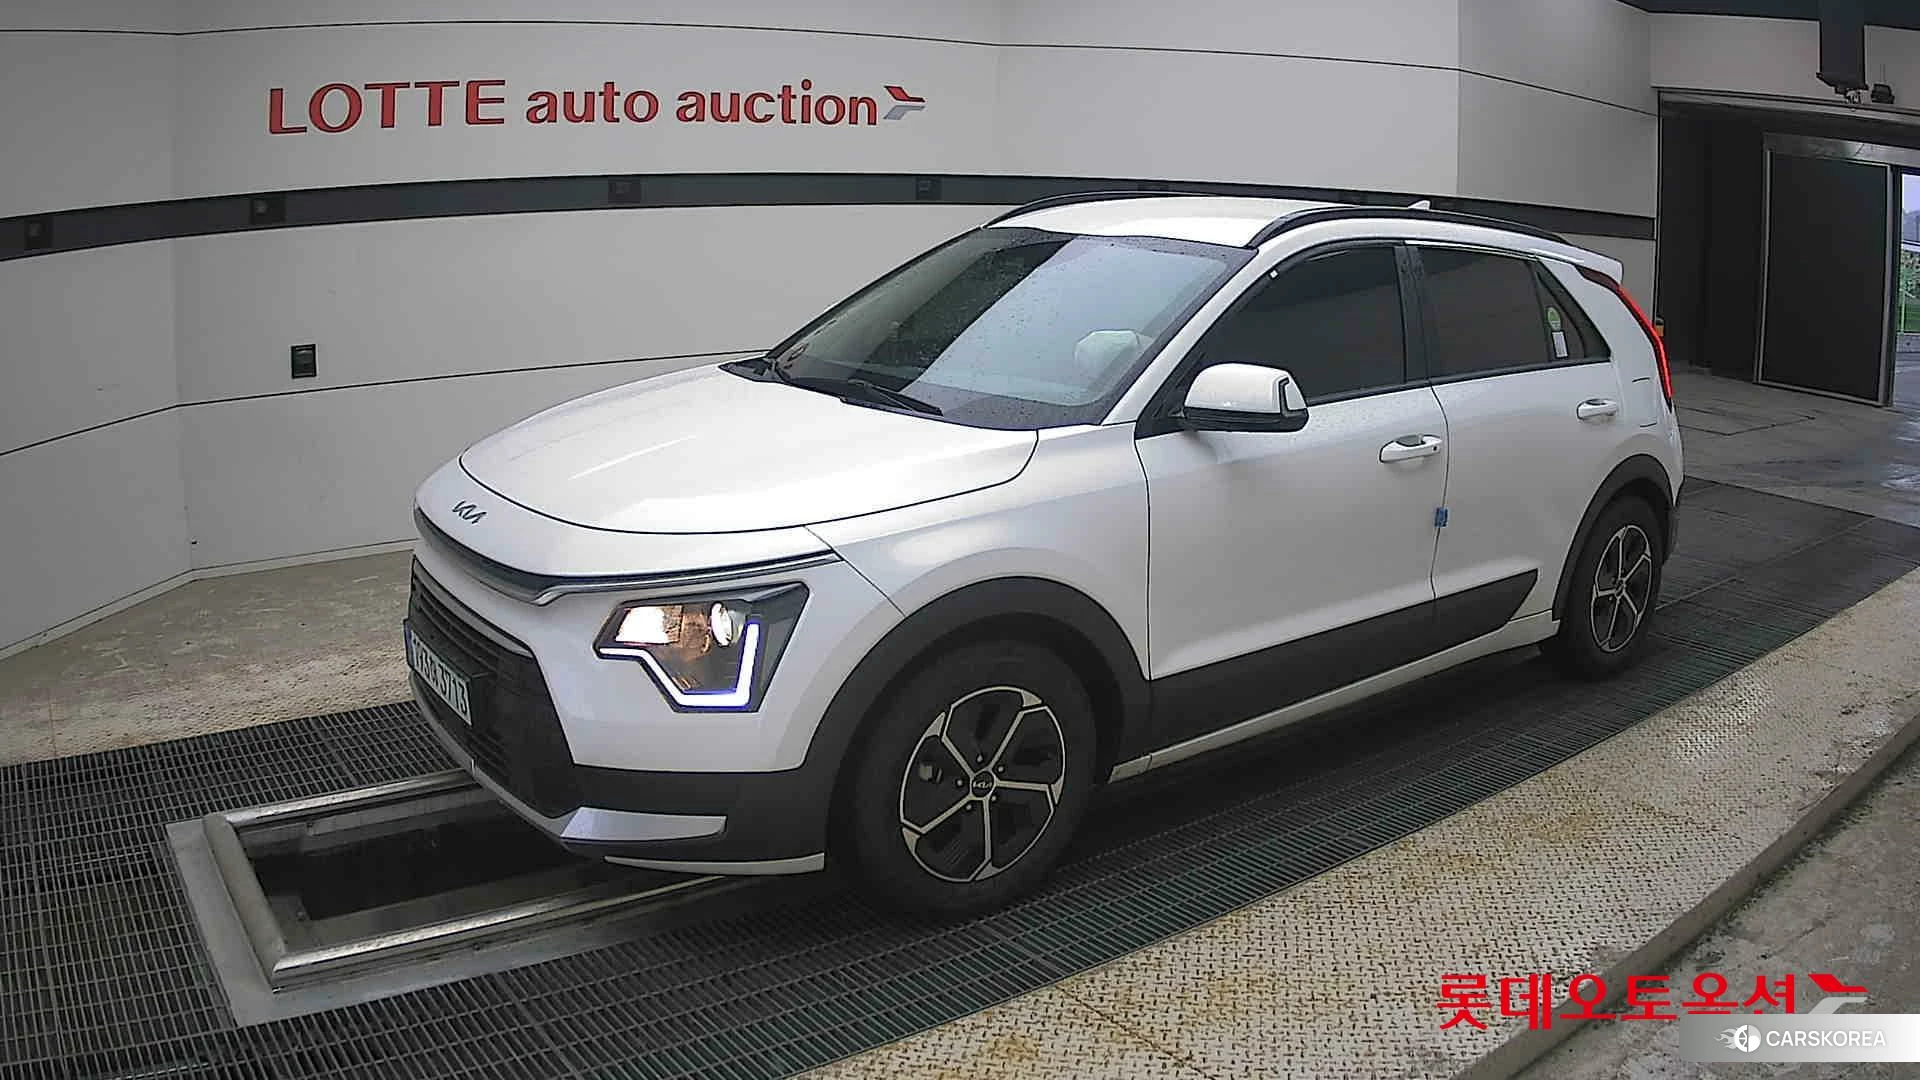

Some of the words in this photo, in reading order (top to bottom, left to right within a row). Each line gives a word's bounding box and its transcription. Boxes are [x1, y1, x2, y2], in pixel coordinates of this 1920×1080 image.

[268, 80, 506, 134] LOTTE
[525, 82, 660, 125] auto
[676, 79, 878, 126] auction
